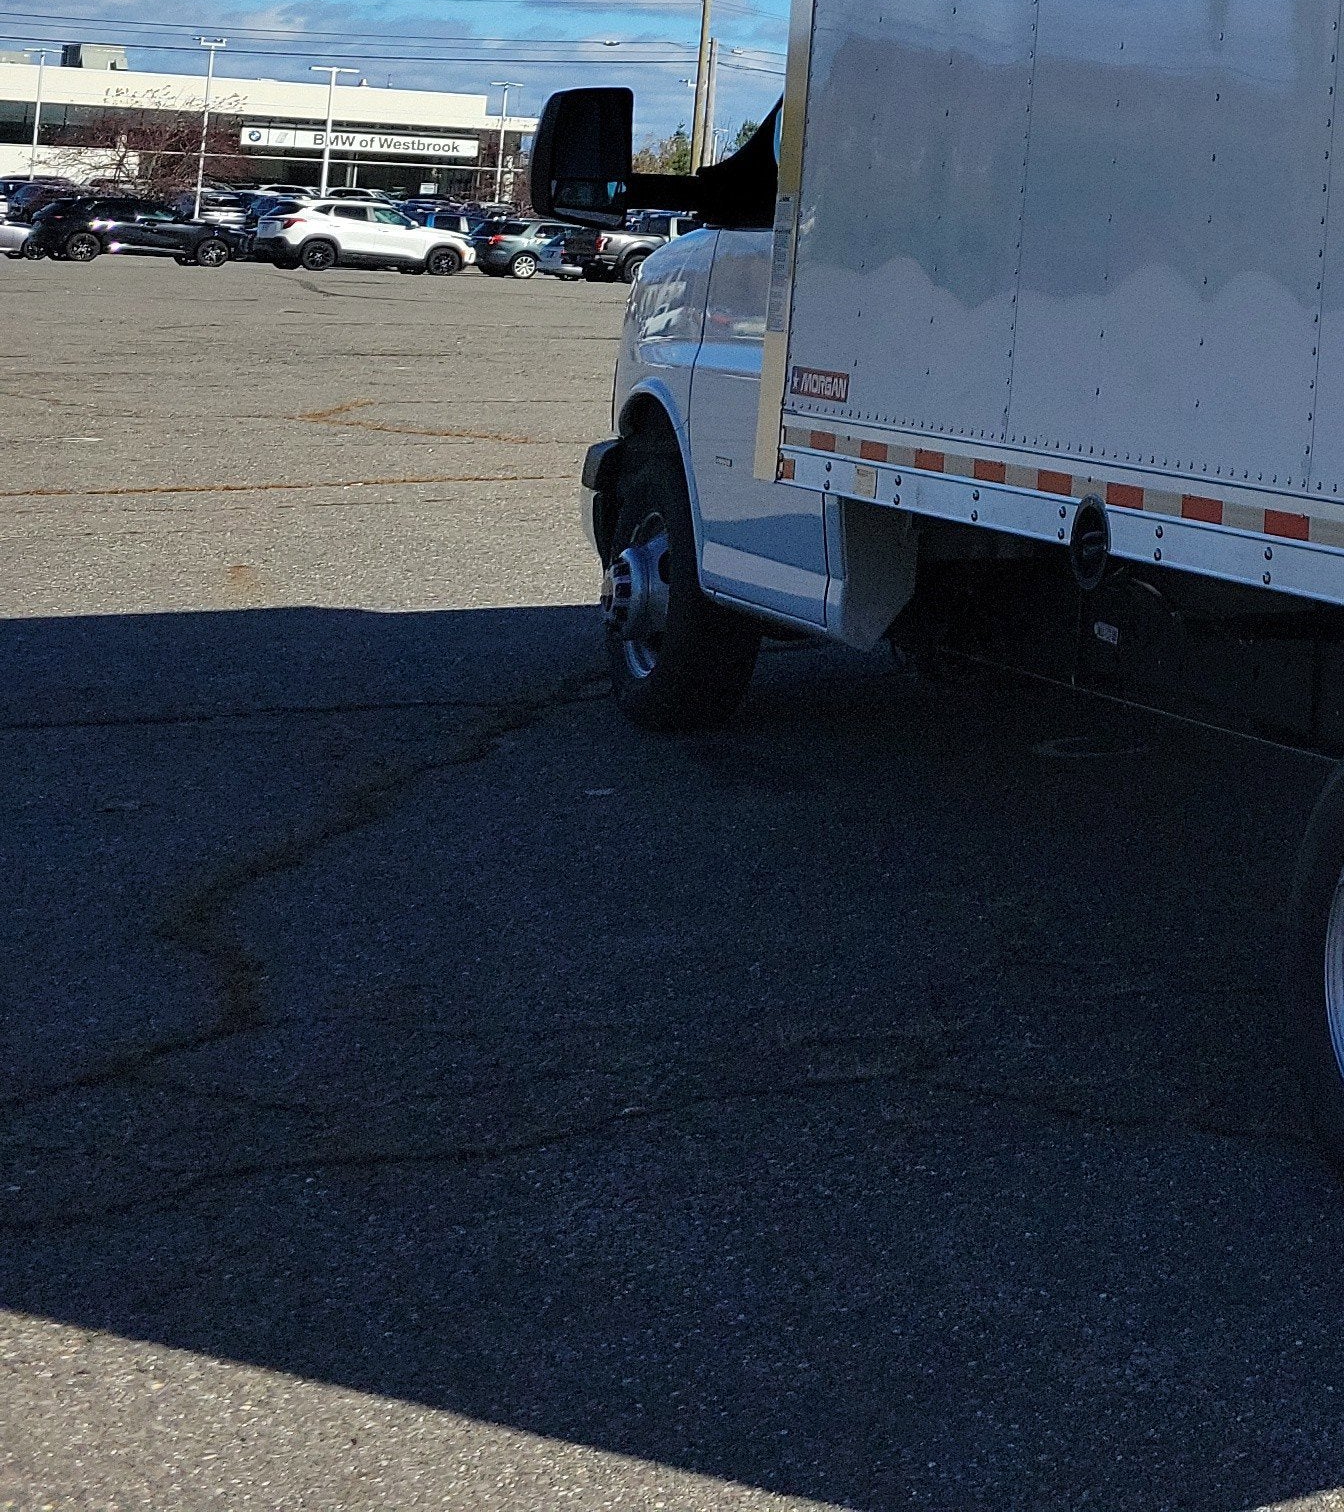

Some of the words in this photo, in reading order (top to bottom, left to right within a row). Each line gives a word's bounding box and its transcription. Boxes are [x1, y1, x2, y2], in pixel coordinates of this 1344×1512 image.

[313, 133, 356, 147] BMW
[359, 136, 376, 149] of
[379, 137, 460, 153] Westbrook
[800, 372, 847, 399] MORGAN
